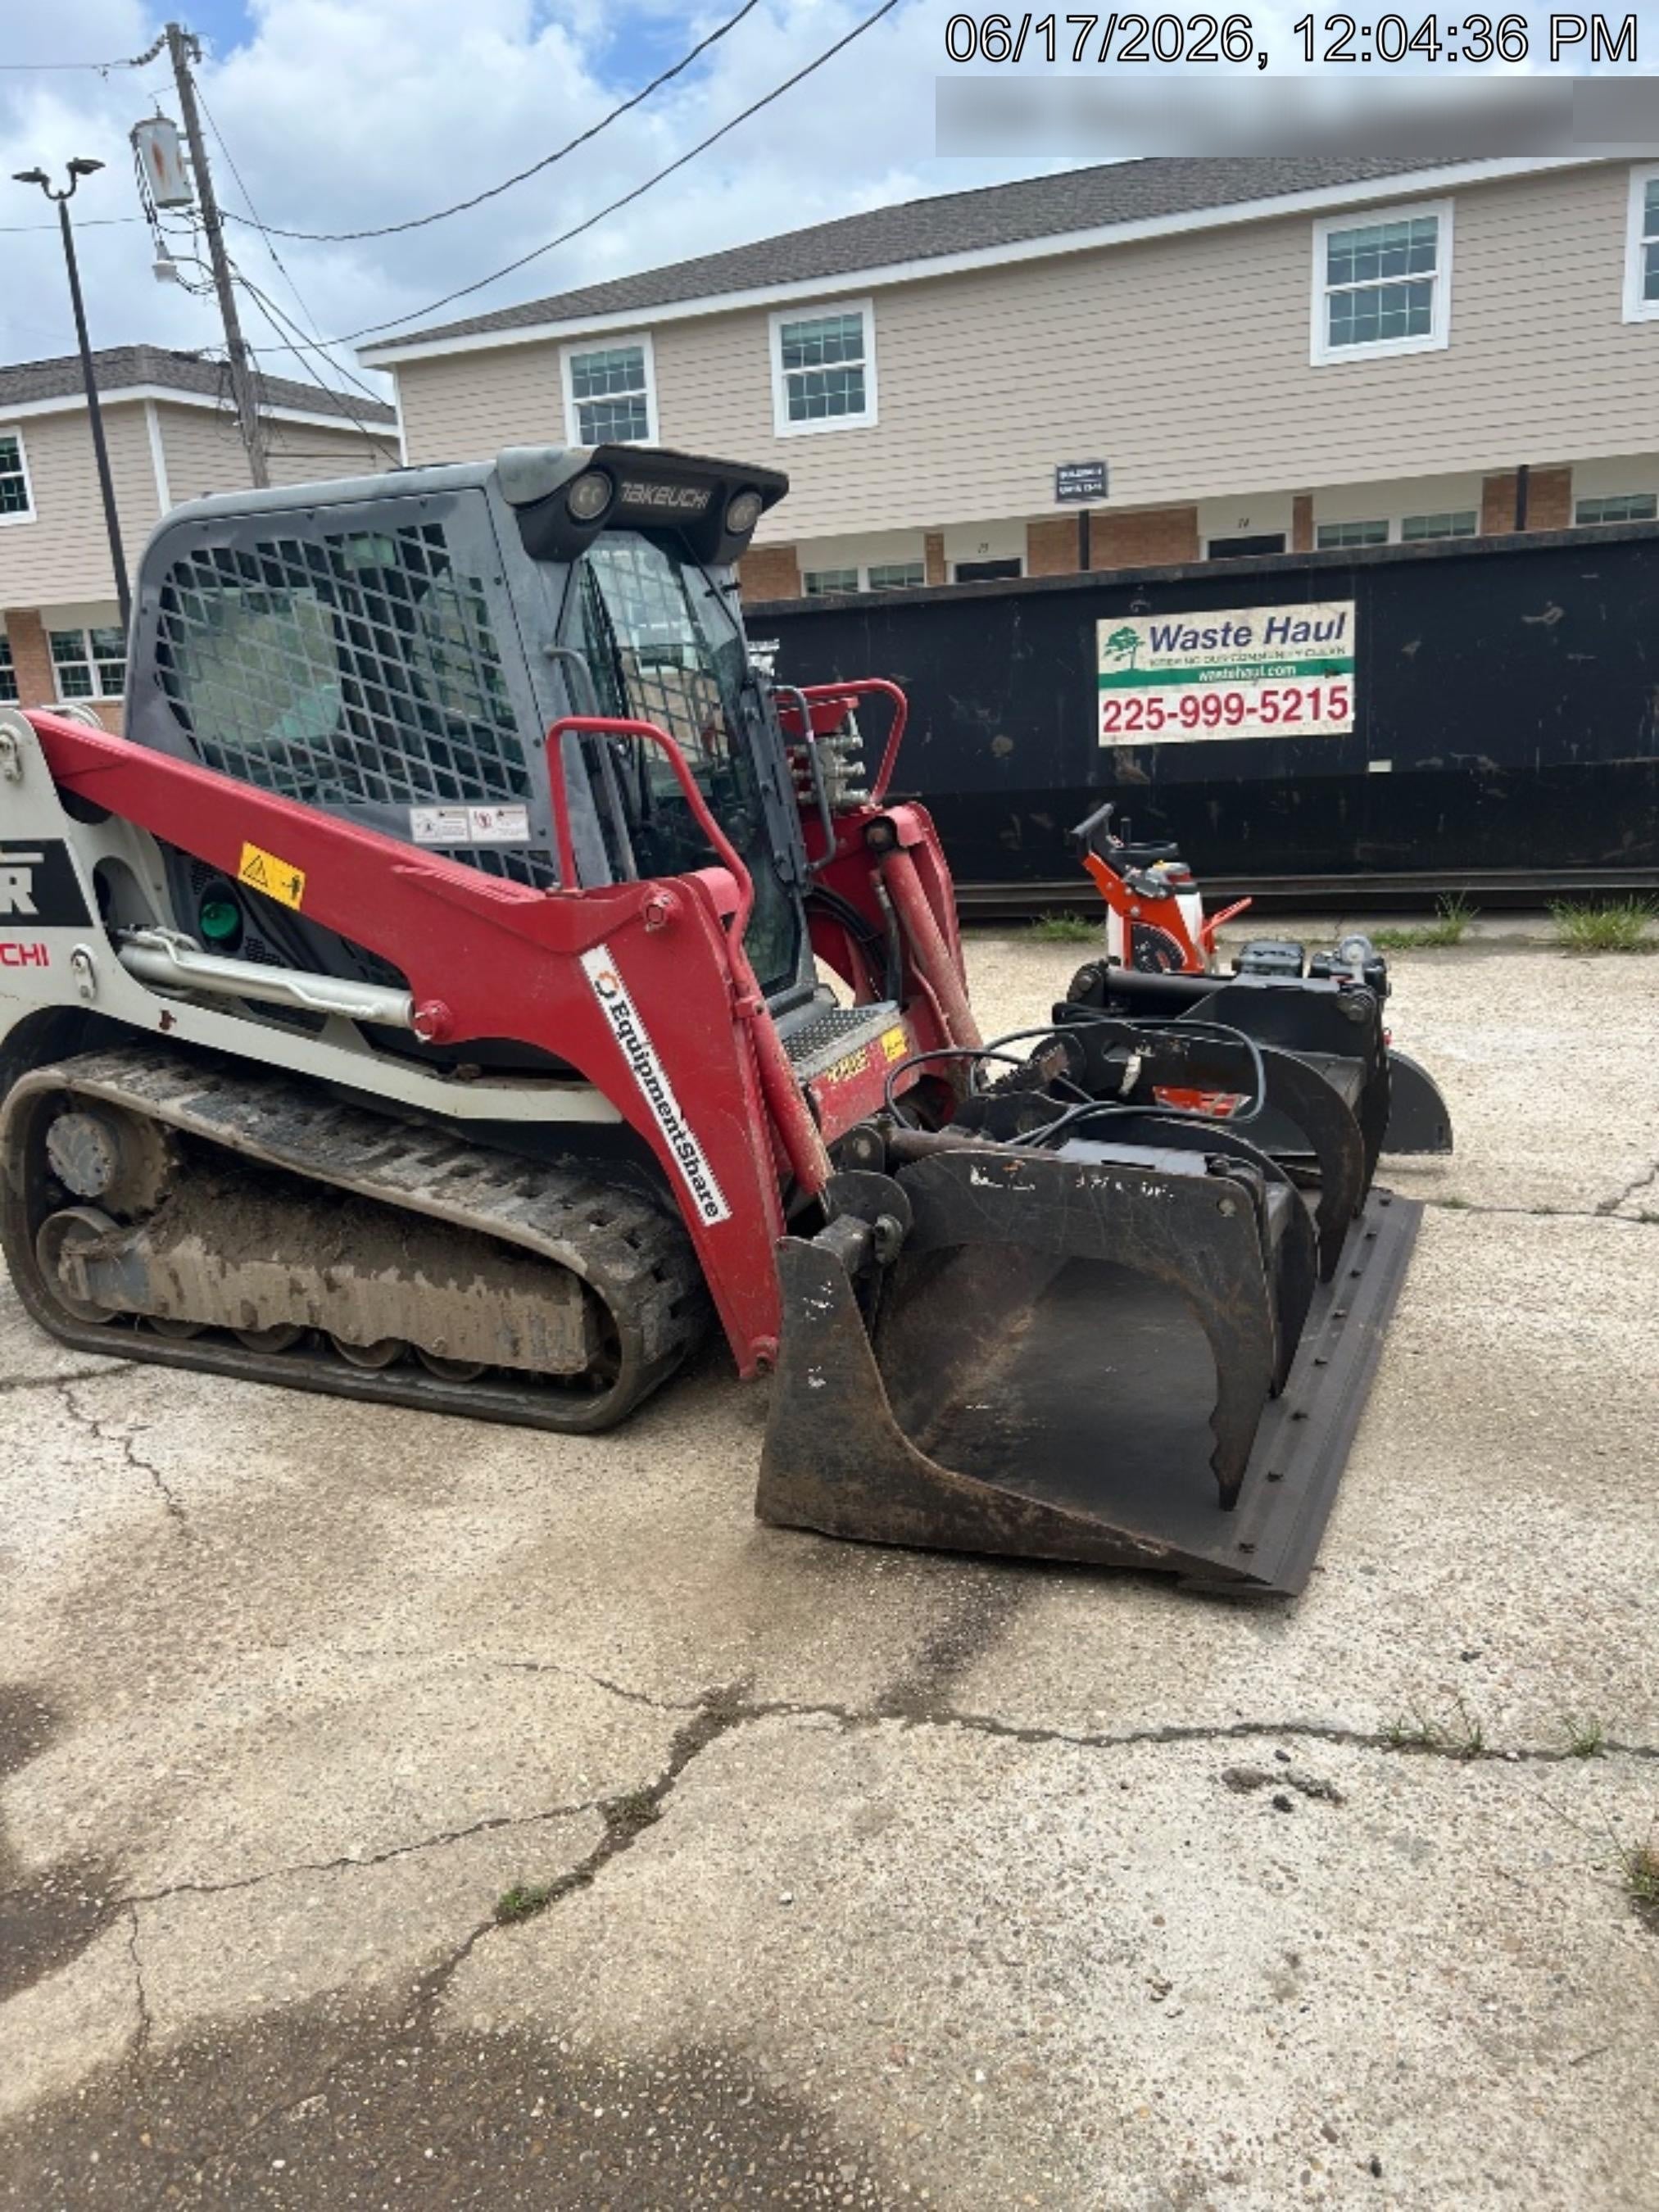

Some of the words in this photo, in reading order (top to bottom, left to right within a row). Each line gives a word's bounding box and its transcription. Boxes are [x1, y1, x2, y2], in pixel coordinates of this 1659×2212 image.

[1149, 621, 1253, 653] Waste
[1263, 611, 1346, 646] Haul
[1149, 656, 1200, 667] KEEPNG
[1231, 650, 1303, 663] COMMUNTY
[1199, 664, 1296, 682] wastehaul.com
[1103, 685, 1349, 733] 225-999-5215
[610, 1000, 718, 1218] EquipmentShare
